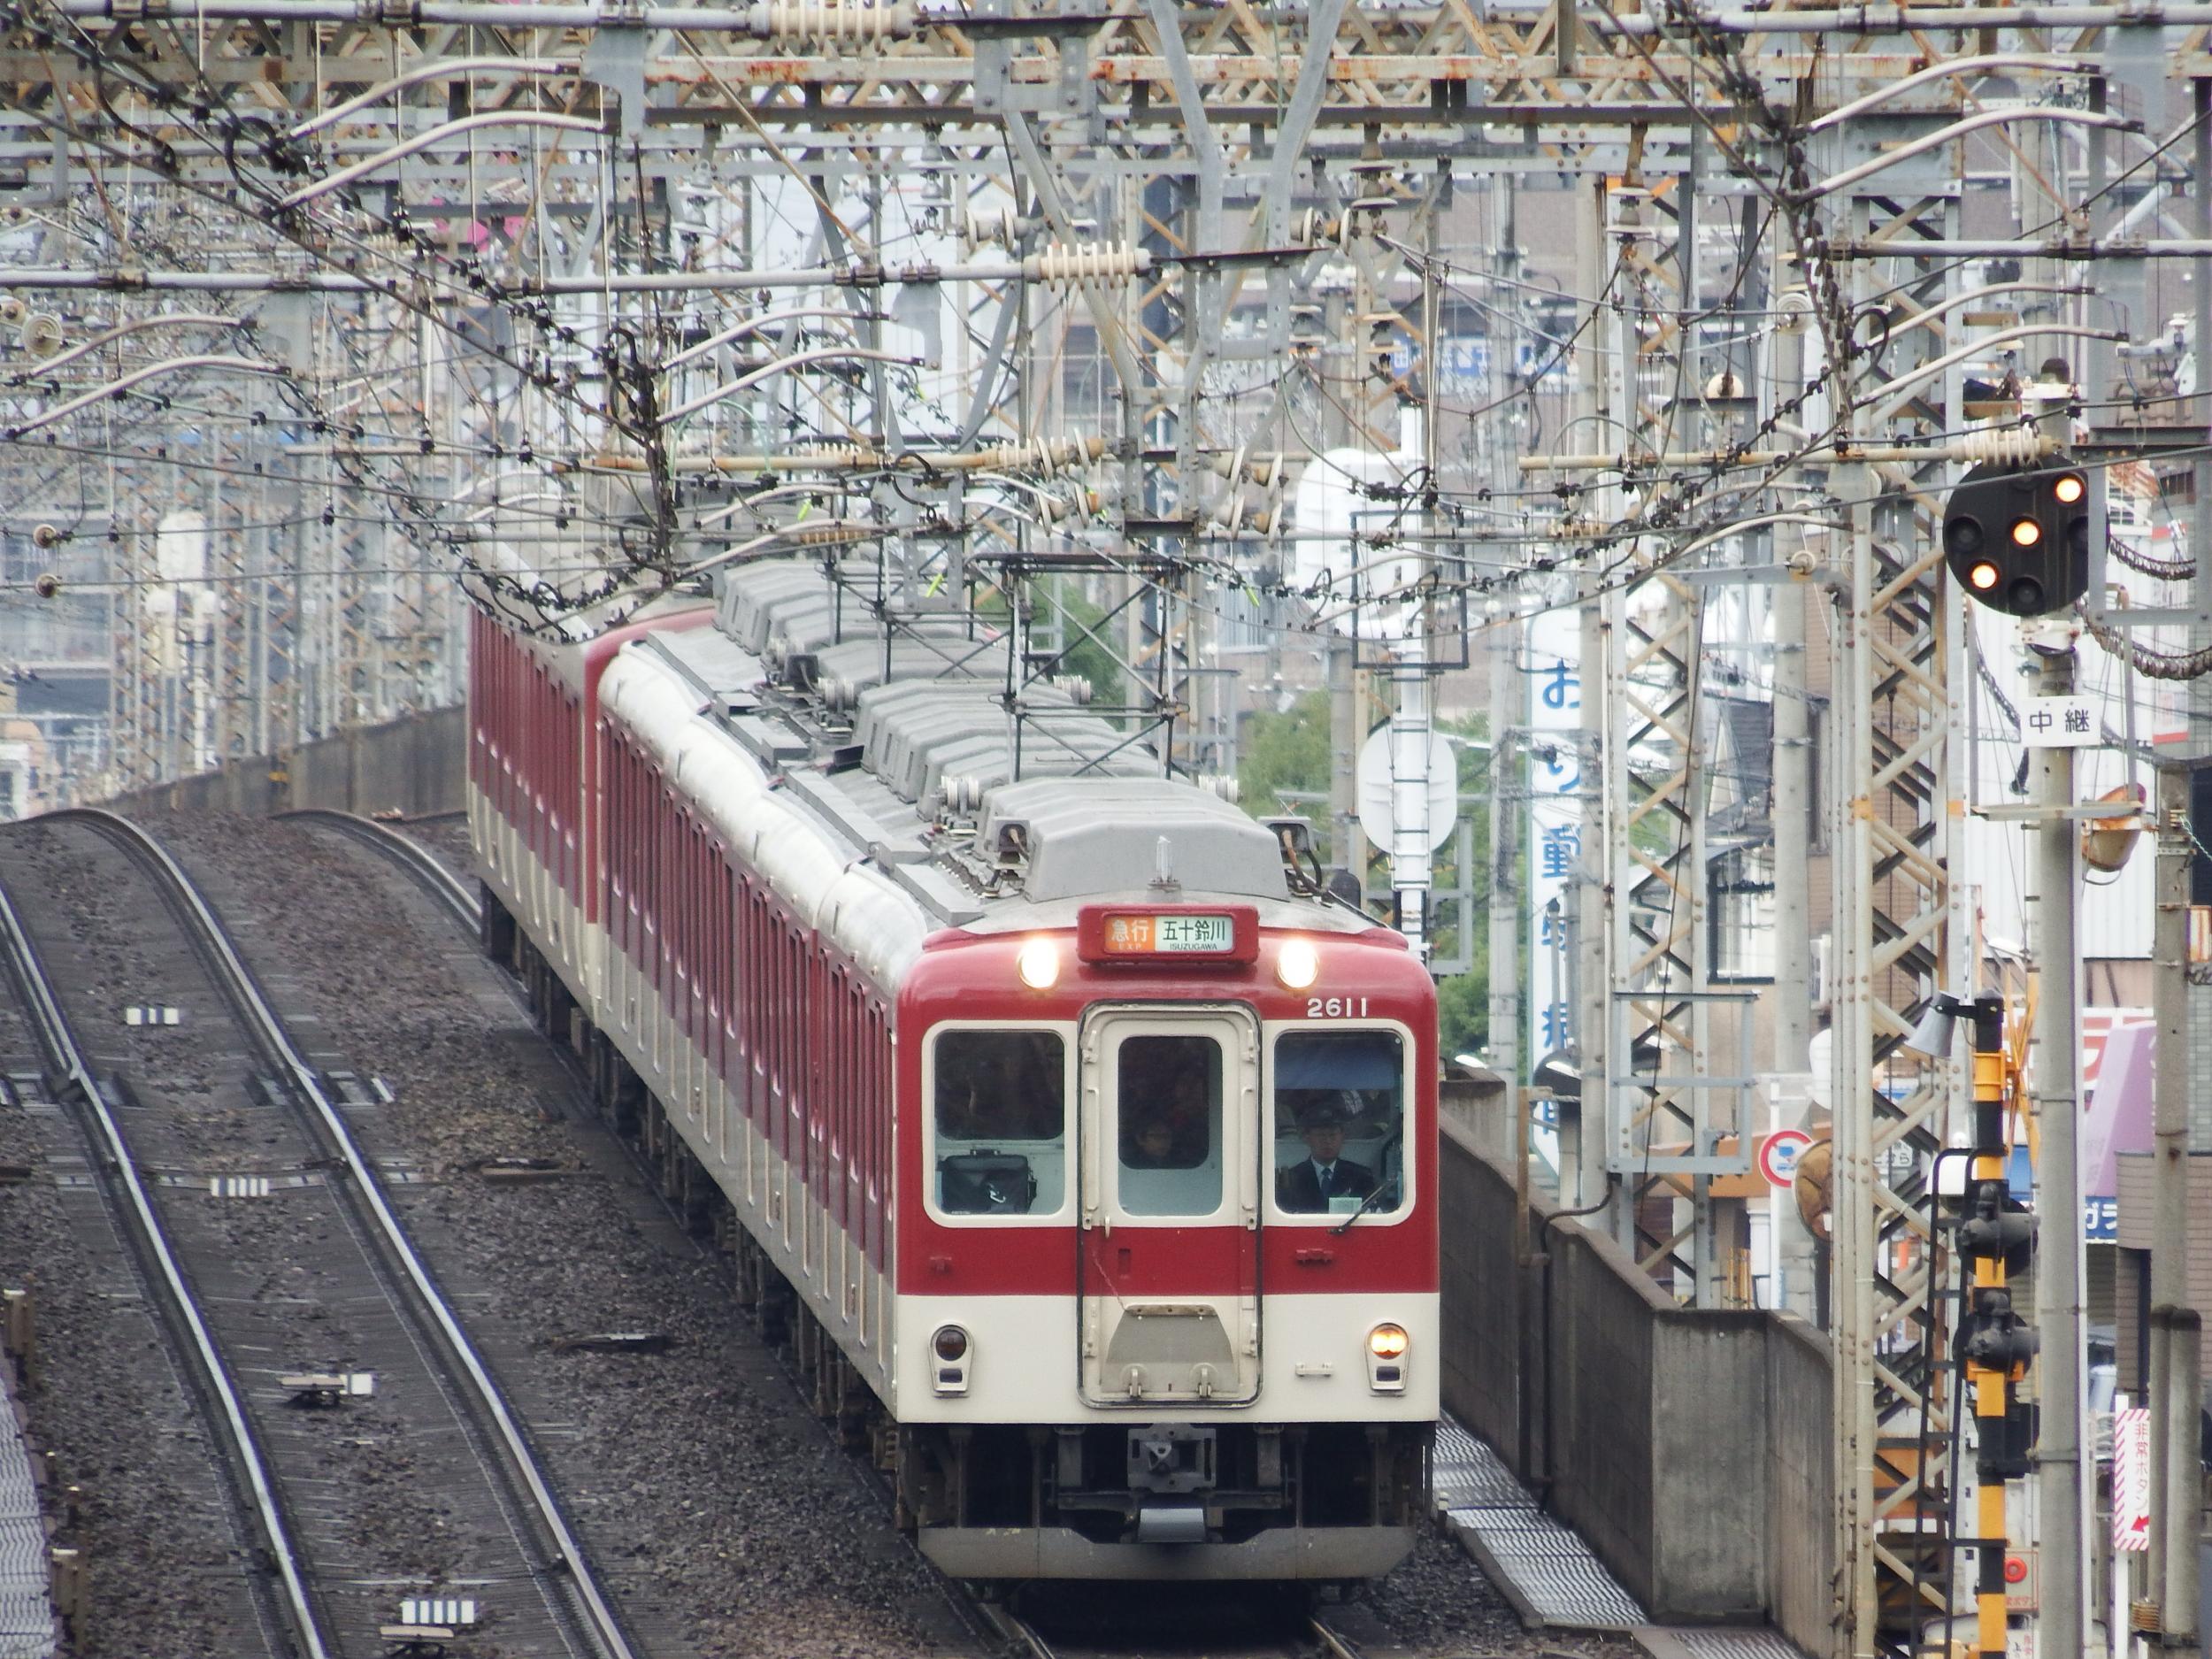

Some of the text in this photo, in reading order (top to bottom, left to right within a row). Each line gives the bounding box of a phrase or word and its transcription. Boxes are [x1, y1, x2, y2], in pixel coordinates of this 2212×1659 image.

[2029, 709, 2090, 733] 中継
[1111, 919, 1148, 942] 急行
[1163, 919, 1225, 941] 五十鈴川
[1307, 997, 1367, 1018] 2611
